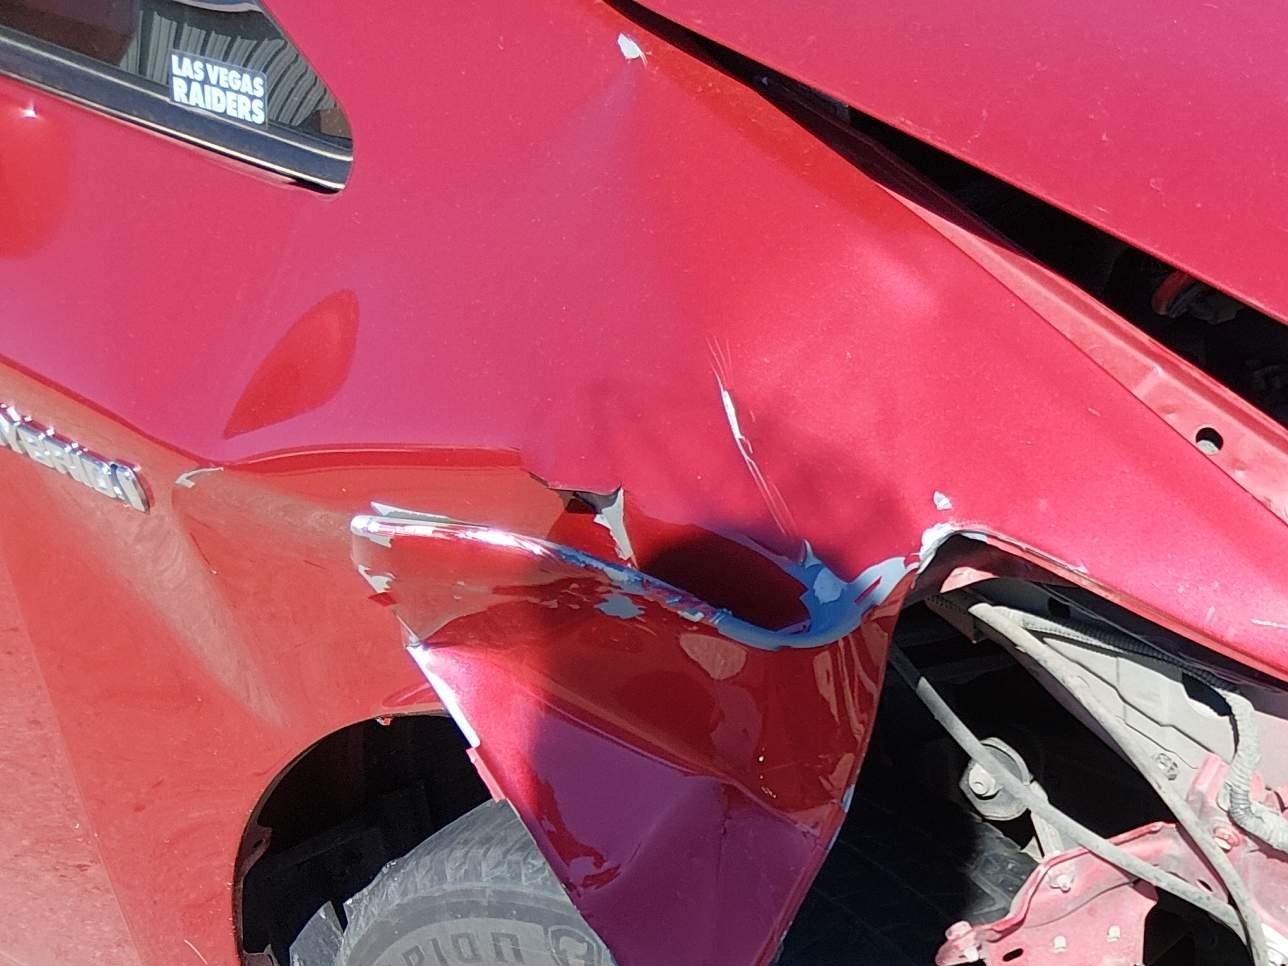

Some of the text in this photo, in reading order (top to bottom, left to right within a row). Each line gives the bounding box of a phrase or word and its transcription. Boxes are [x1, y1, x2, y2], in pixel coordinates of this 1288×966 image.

[171, 54, 265, 97] LAS VEGAS
[172, 76, 265, 124] RAIDERS
